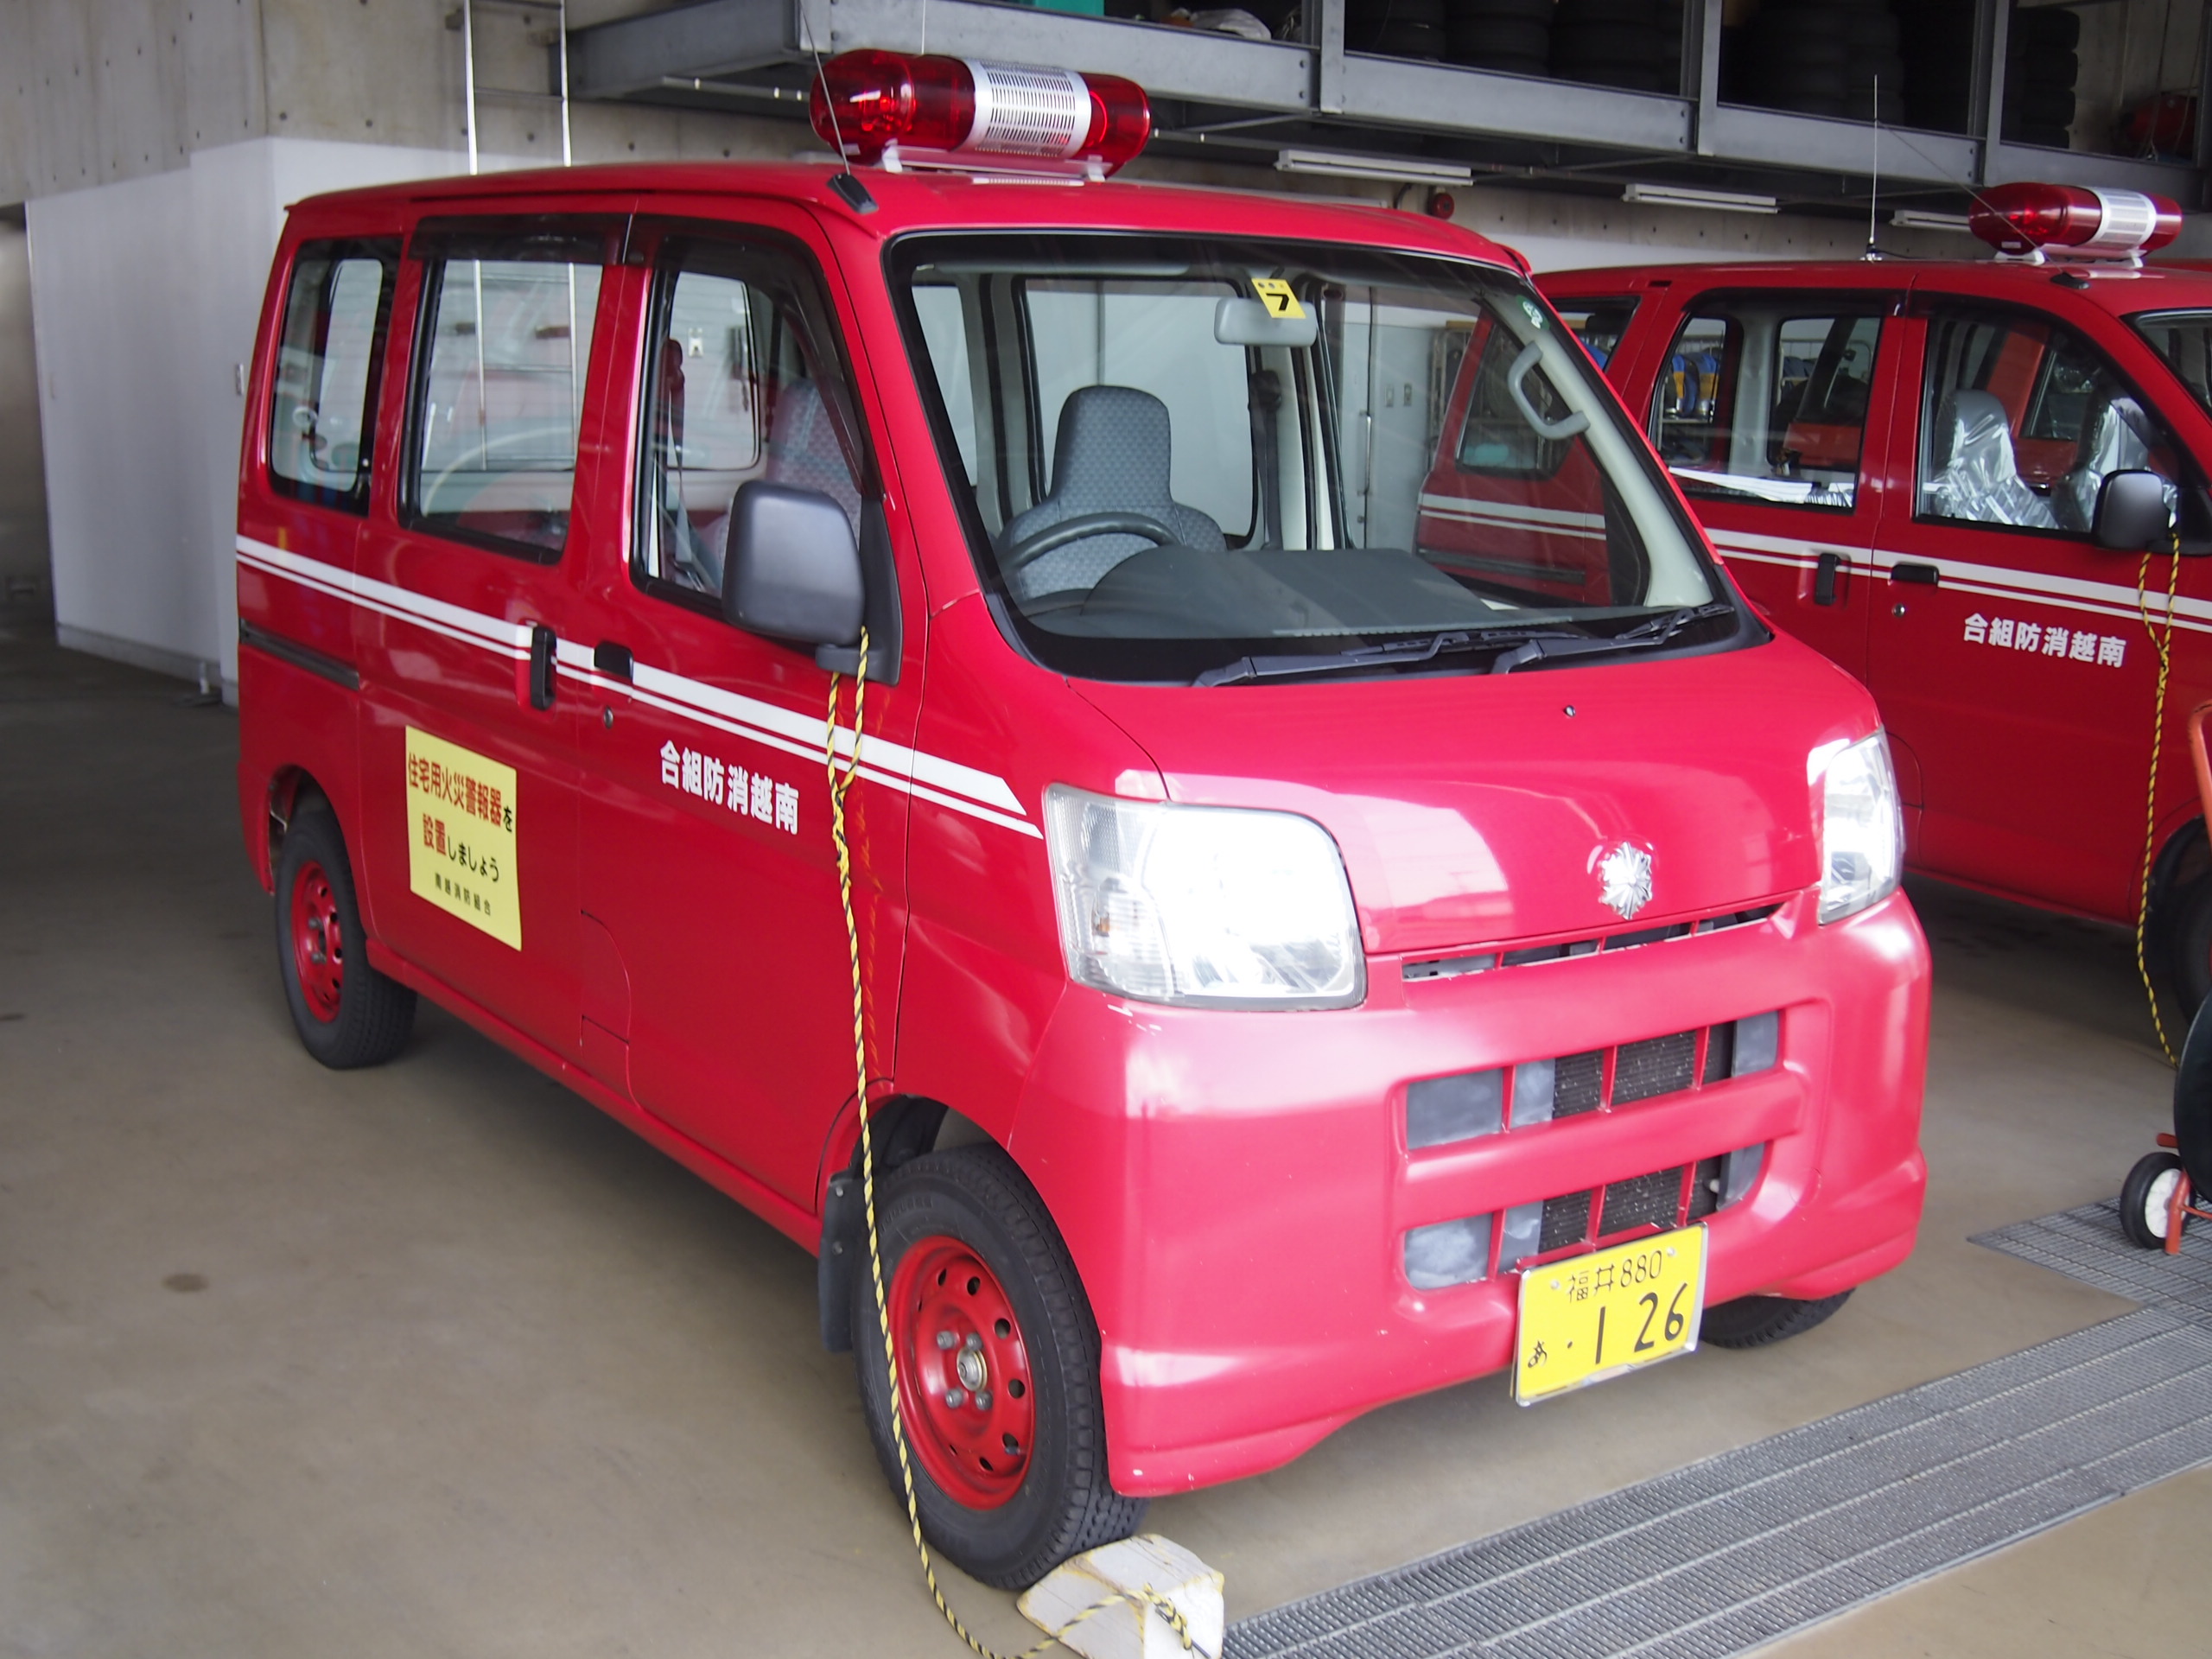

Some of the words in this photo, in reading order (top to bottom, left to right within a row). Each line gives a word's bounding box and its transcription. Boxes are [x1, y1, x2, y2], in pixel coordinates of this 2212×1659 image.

[408, 752, 512, 832] 住宅用火災警報器を
[423, 813, 499, 883] 設置しましょう
